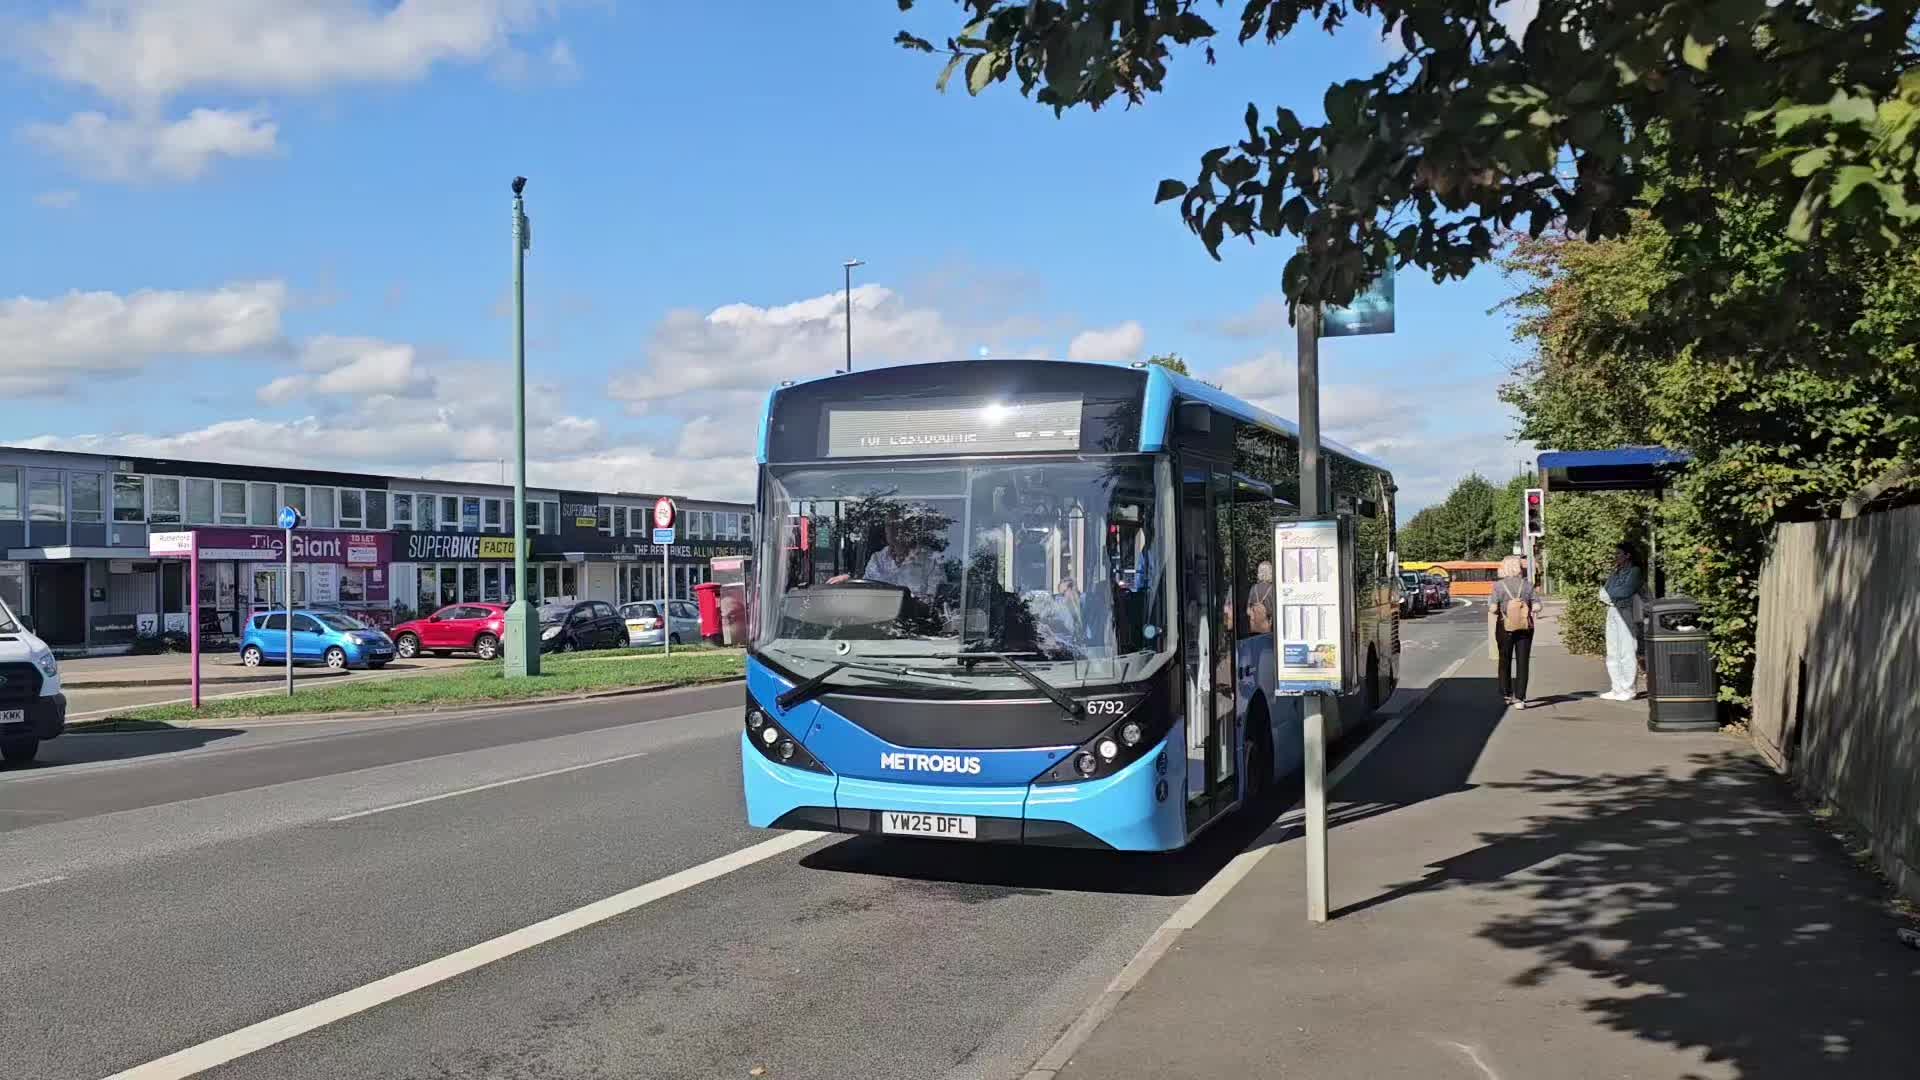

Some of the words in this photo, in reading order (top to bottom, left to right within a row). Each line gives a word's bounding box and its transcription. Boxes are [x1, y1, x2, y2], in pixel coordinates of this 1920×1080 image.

[291, 535, 341, 557] Giant
[408, 534, 480, 559] SUPERBIKE
[483, 540, 515, 553] FACTO
[633, 544, 649, 556] THE
[650, 545, 665, 556] BES
[141, 620, 154, 632] 57
[1087, 700, 1124, 715] 6792
[880, 751, 981, 775] METROBUS
[890, 814, 932, 832] YW25
[936, 816, 969, 835] DFL
